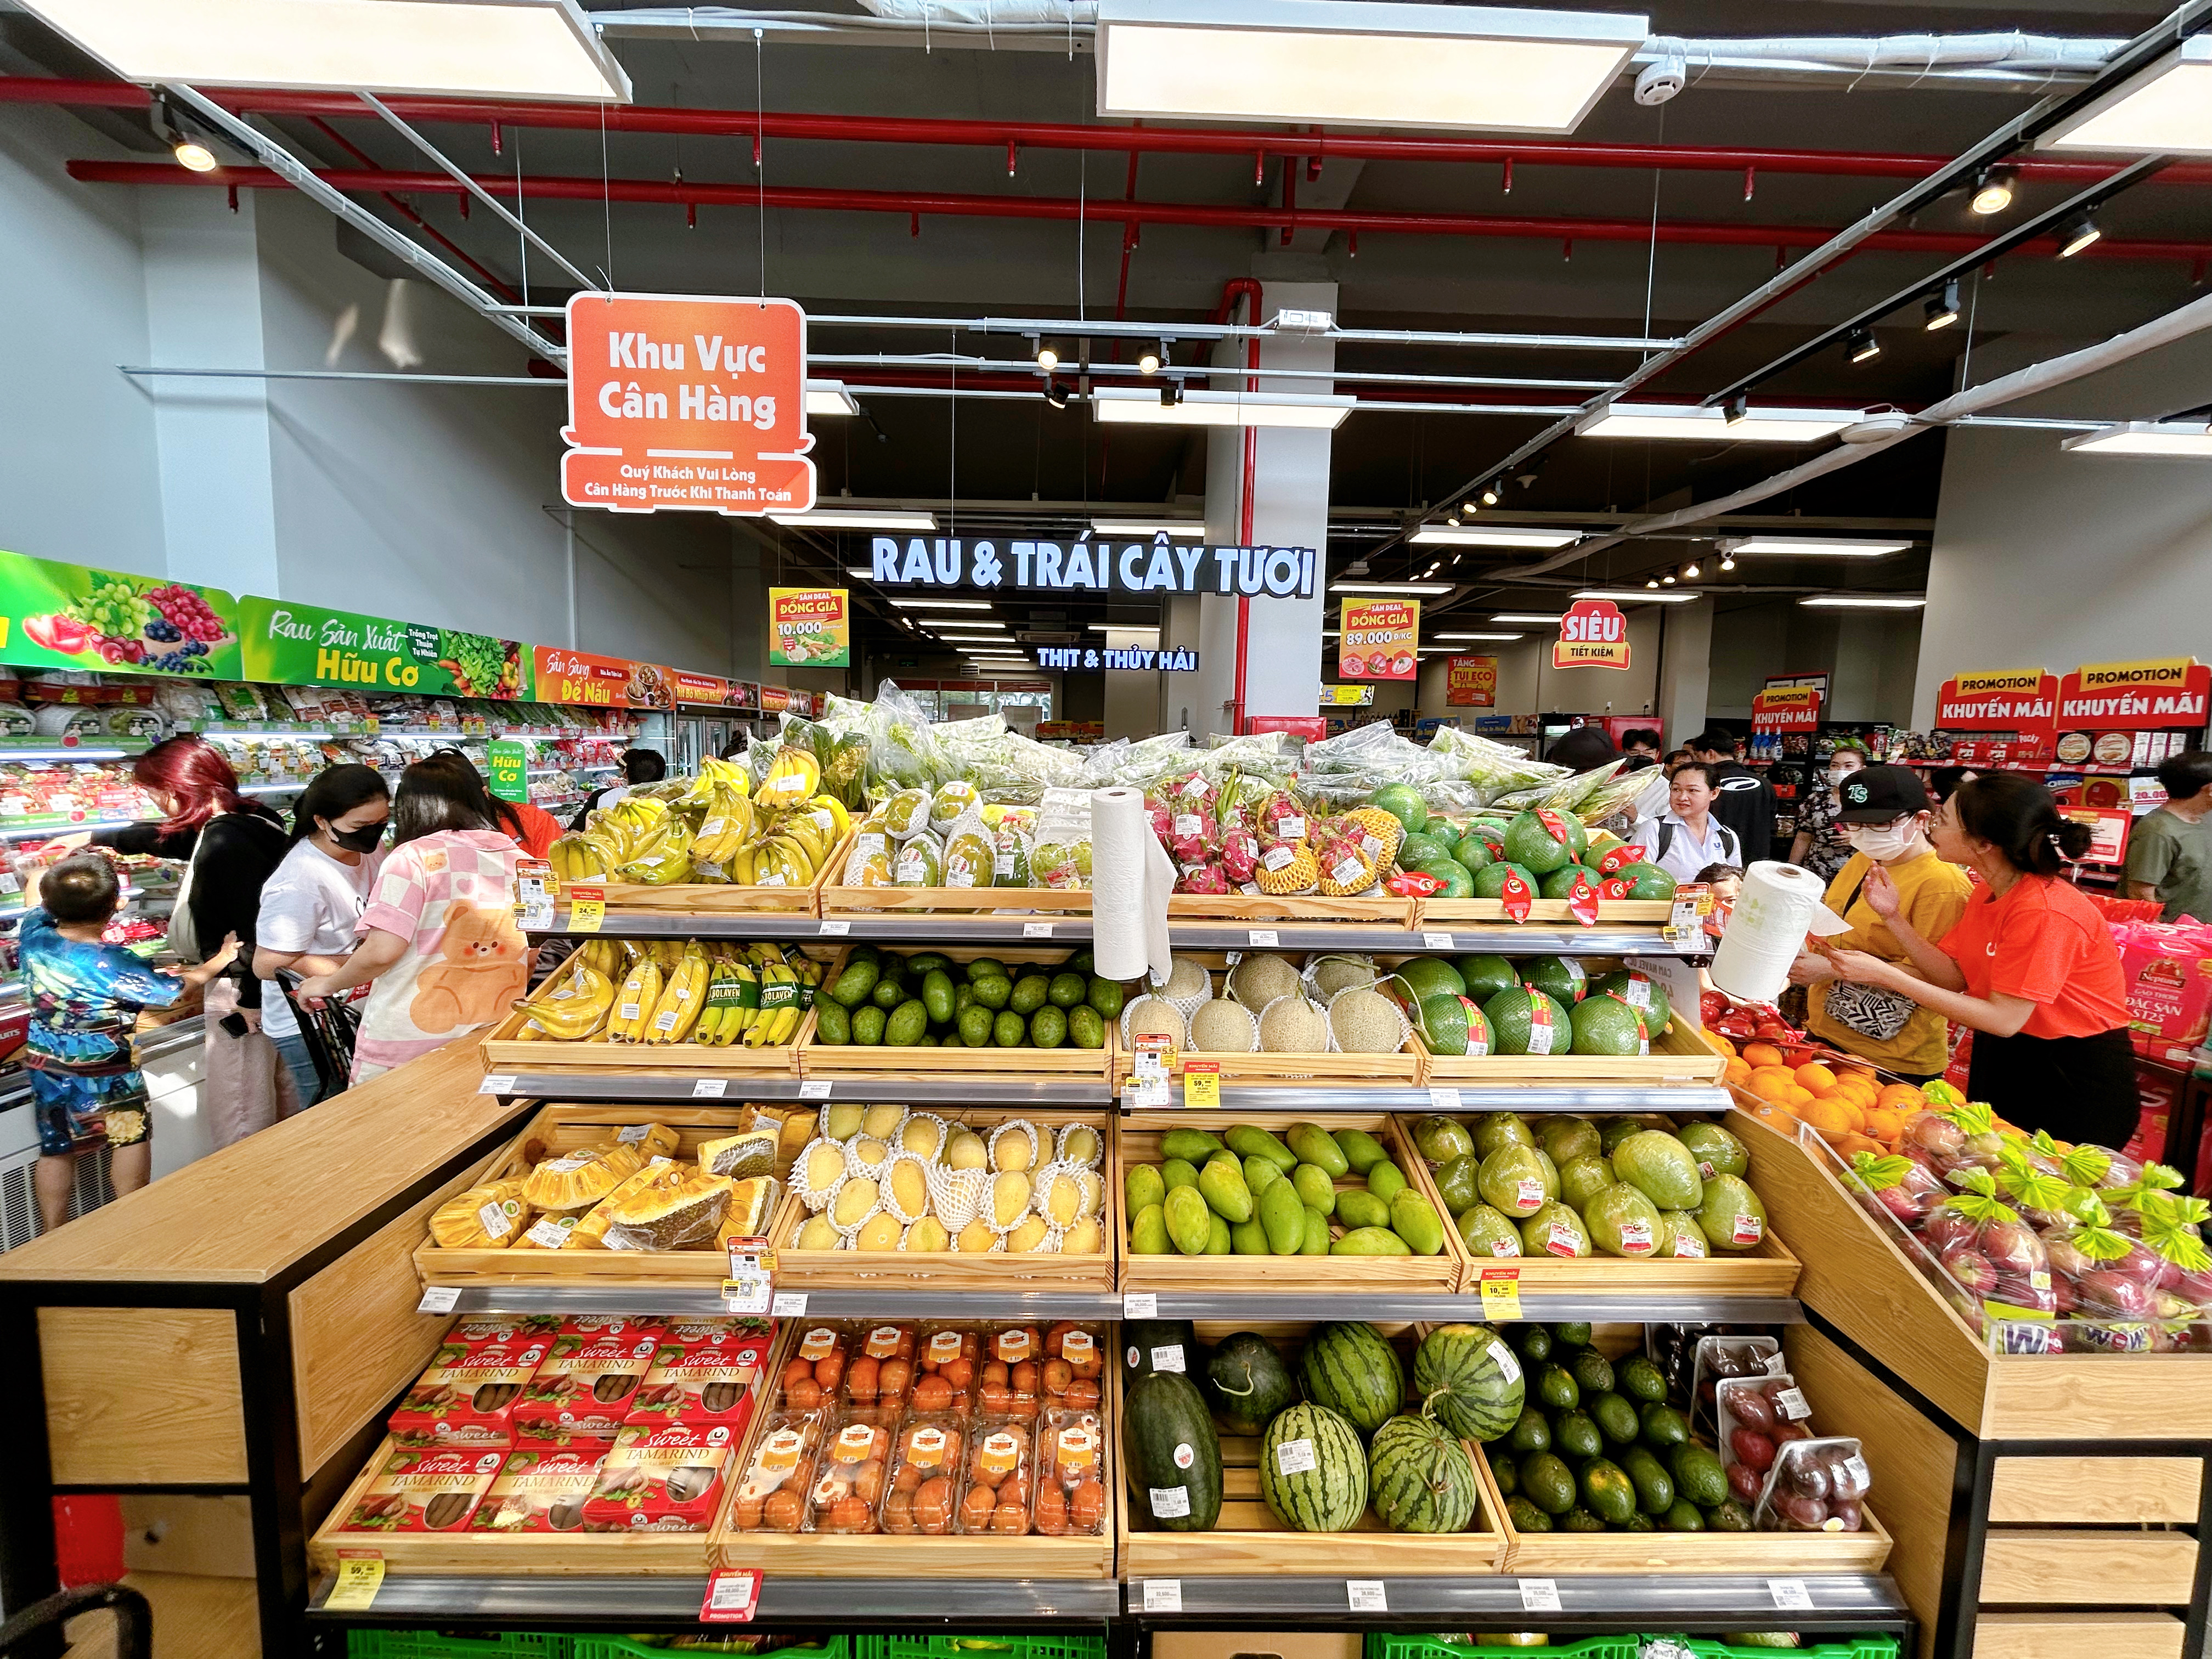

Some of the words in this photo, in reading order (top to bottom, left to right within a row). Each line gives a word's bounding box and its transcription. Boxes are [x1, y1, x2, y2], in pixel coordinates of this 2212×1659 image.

[609, 332, 684, 370] Khu
[694, 335, 765, 379] Vực
[599, 381, 667, 419] Cân
[679, 385, 776, 430] Hàng
[620, 464, 650, 481] Quý
[653, 465, 693, 481] Khách
[697, 466, 719, 481] Vui
[722, 467, 755, 484] Lòng
[584, 482, 610, 496] Cân
[612, 483, 647, 500] Hàng
[649, 483, 687, 499] Trước
[690, 485, 712, 499] Khi
[715, 486, 755, 500] Thanh
[758, 487, 791, 501] Toán
[873, 537, 961, 584] RAU
[972, 545, 1002, 588] &
[1011, 530, 1110, 589] TRÁI
[1119, 532, 1205, 591] CÂY
[1214, 546, 1314, 595] TƯƠI
[780, 600, 814, 614] ĐỒNG
[816, 598, 838, 612] GIÁ
[1351, 612, 1385, 627] ĐỒNG
[1387, 610, 1409, 625] GIÁ
[1566, 610, 1620, 641] SIÊU
[269, 610, 316, 641] Rau
[319, 619, 358, 647] Sản
[362, 624, 408, 652] Xuất
[777, 621, 822, 635] 10.000
[1346, 631, 1392, 645] 89.000
[1037, 647, 1080, 672] THỊT
[1084, 650, 1099, 668] &
[1103, 645, 1154, 670] THỦY
[1160, 646, 1195, 670] HẢI
[1571, 644, 1589, 657] TIẾT
[1591, 645, 1613, 659] KIỆM
[316, 648, 378, 684] Hữu
[385, 657, 419, 686] Cơ
[567, 657, 590, 680] Sàng
[1454, 669, 1469, 680] TÚI
[1471, 671, 1493, 681] ECO
[2087, 668, 2182, 684] PROMOTION
[562, 677, 581, 702] Để
[584, 680, 610, 704] Nấu
[1961, 676, 2037, 690] PROMOTION
[1766, 693, 1808, 703] PROMOTION
[2062, 691, 2148, 716] KHUYẾN
[2153, 691, 2204, 714] MÃI
[1755, 707, 1793, 724] KHUYẾN
[1795, 708, 1816, 723] MÃI
[1942, 697, 2012, 719] KHUYẾN
[2013, 697, 2052, 718] MÃI
[493, 756, 522, 768] Hữu
[499, 769, 517, 781] Cơ
[2047, 779, 2078, 788] OREO
[2141, 972, 2182, 986] Neptune
[712, 988, 741, 998] BOLAVEN
[765, 990, 793, 1001] BOLAVEN
[2132, 1008, 2166, 1023] ST25
[558, 1360, 635, 1370] TAMARIND
[438, 1368, 520, 1379] TAMARIND
[663, 1368, 740, 1378] TAMARIND
[626, 1448, 710, 1460] TAMARIND
[390, 1475, 476, 1486] TAMARIND
[511, 1475, 595, 1487] TAMARIND
[720, 1568, 742, 1578] KHUYẾN
